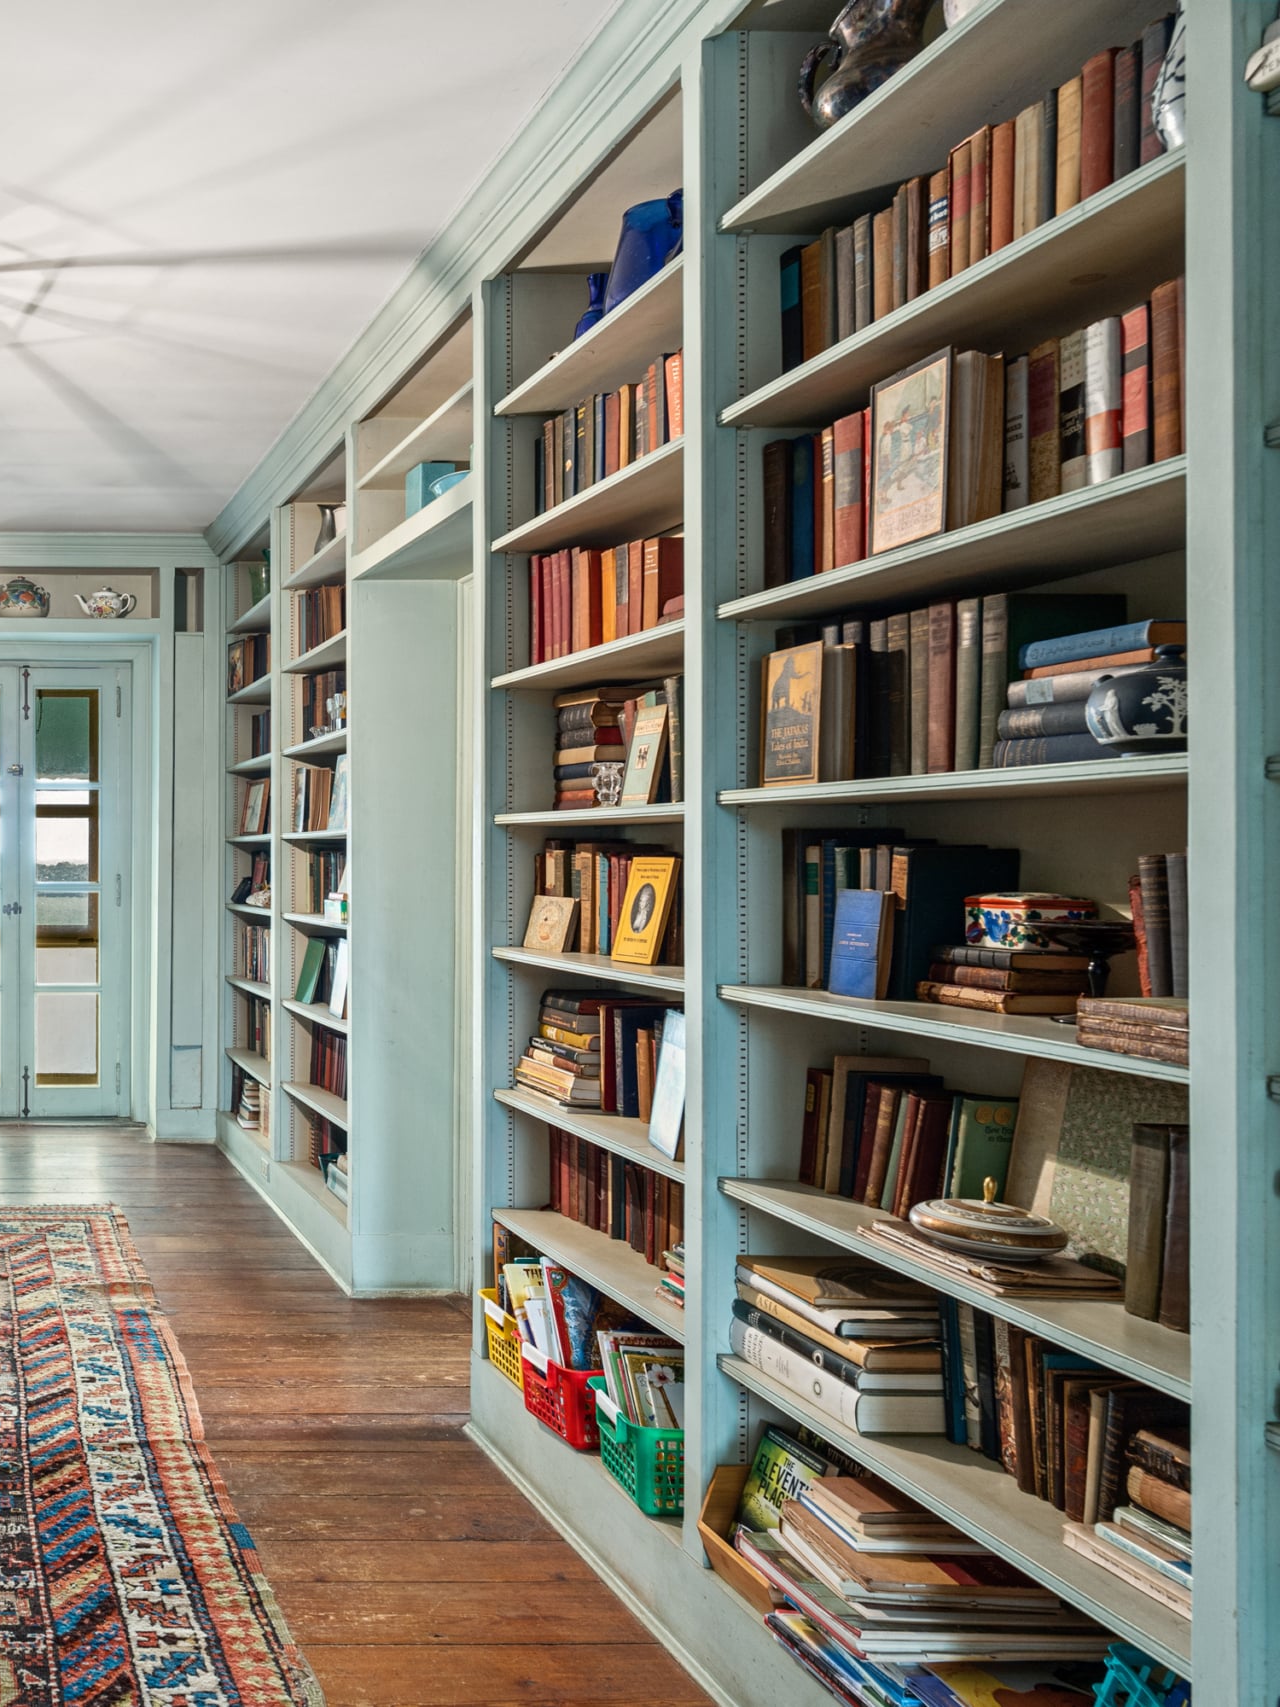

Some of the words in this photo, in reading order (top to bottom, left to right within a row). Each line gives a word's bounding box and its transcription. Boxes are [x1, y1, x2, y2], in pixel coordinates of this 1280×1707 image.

[672, 359, 681, 383] THE
[771, 727, 784, 739] THE
[756, 1296, 778, 1315] ASIA
[756, 1452, 814, 1497] ELEVENT
[783, 1457, 796, 1472] THE
[757, 1477, 793, 1509] PLAG
